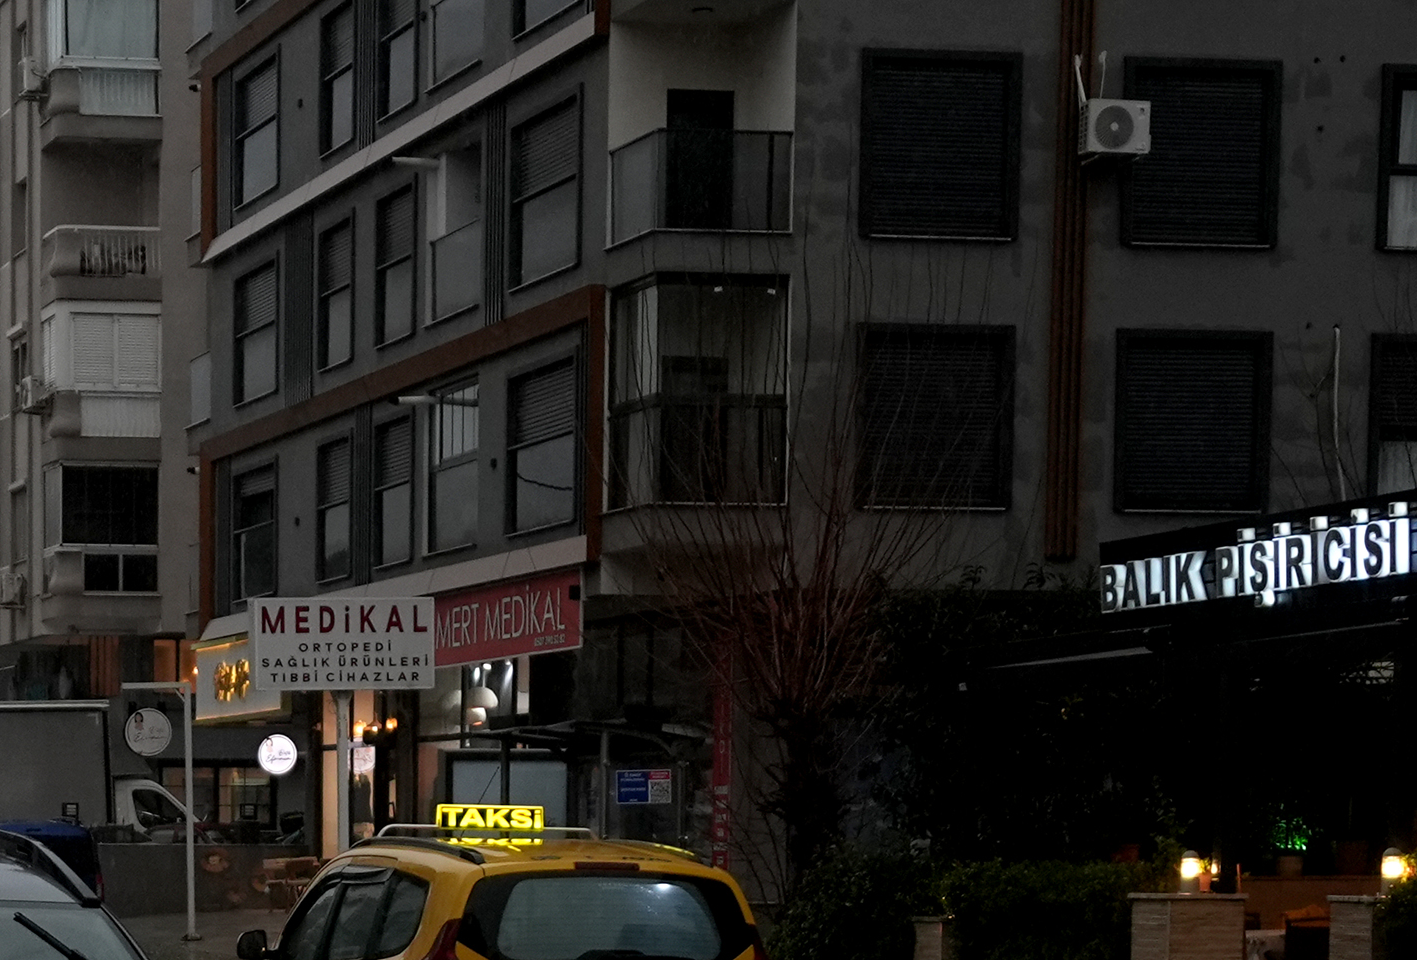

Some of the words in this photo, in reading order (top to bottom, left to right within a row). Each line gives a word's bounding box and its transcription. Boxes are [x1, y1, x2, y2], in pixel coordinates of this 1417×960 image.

[1100, 550, 1207, 613] BALIK
[1216, 501, 1410, 608] PİŞİRİCİSİ
[436, 603, 480, 649] MERT
[484, 584, 566, 641] MEDİKAL
[298, 640, 392, 652] ORTOPEDİ
[262, 655, 330, 668] SAĞLIK
[338, 654, 428, 667] ÜRÜNLERİ
[270, 670, 318, 682] TIBBİ
[326, 670, 420, 682] CİHAZLAR
